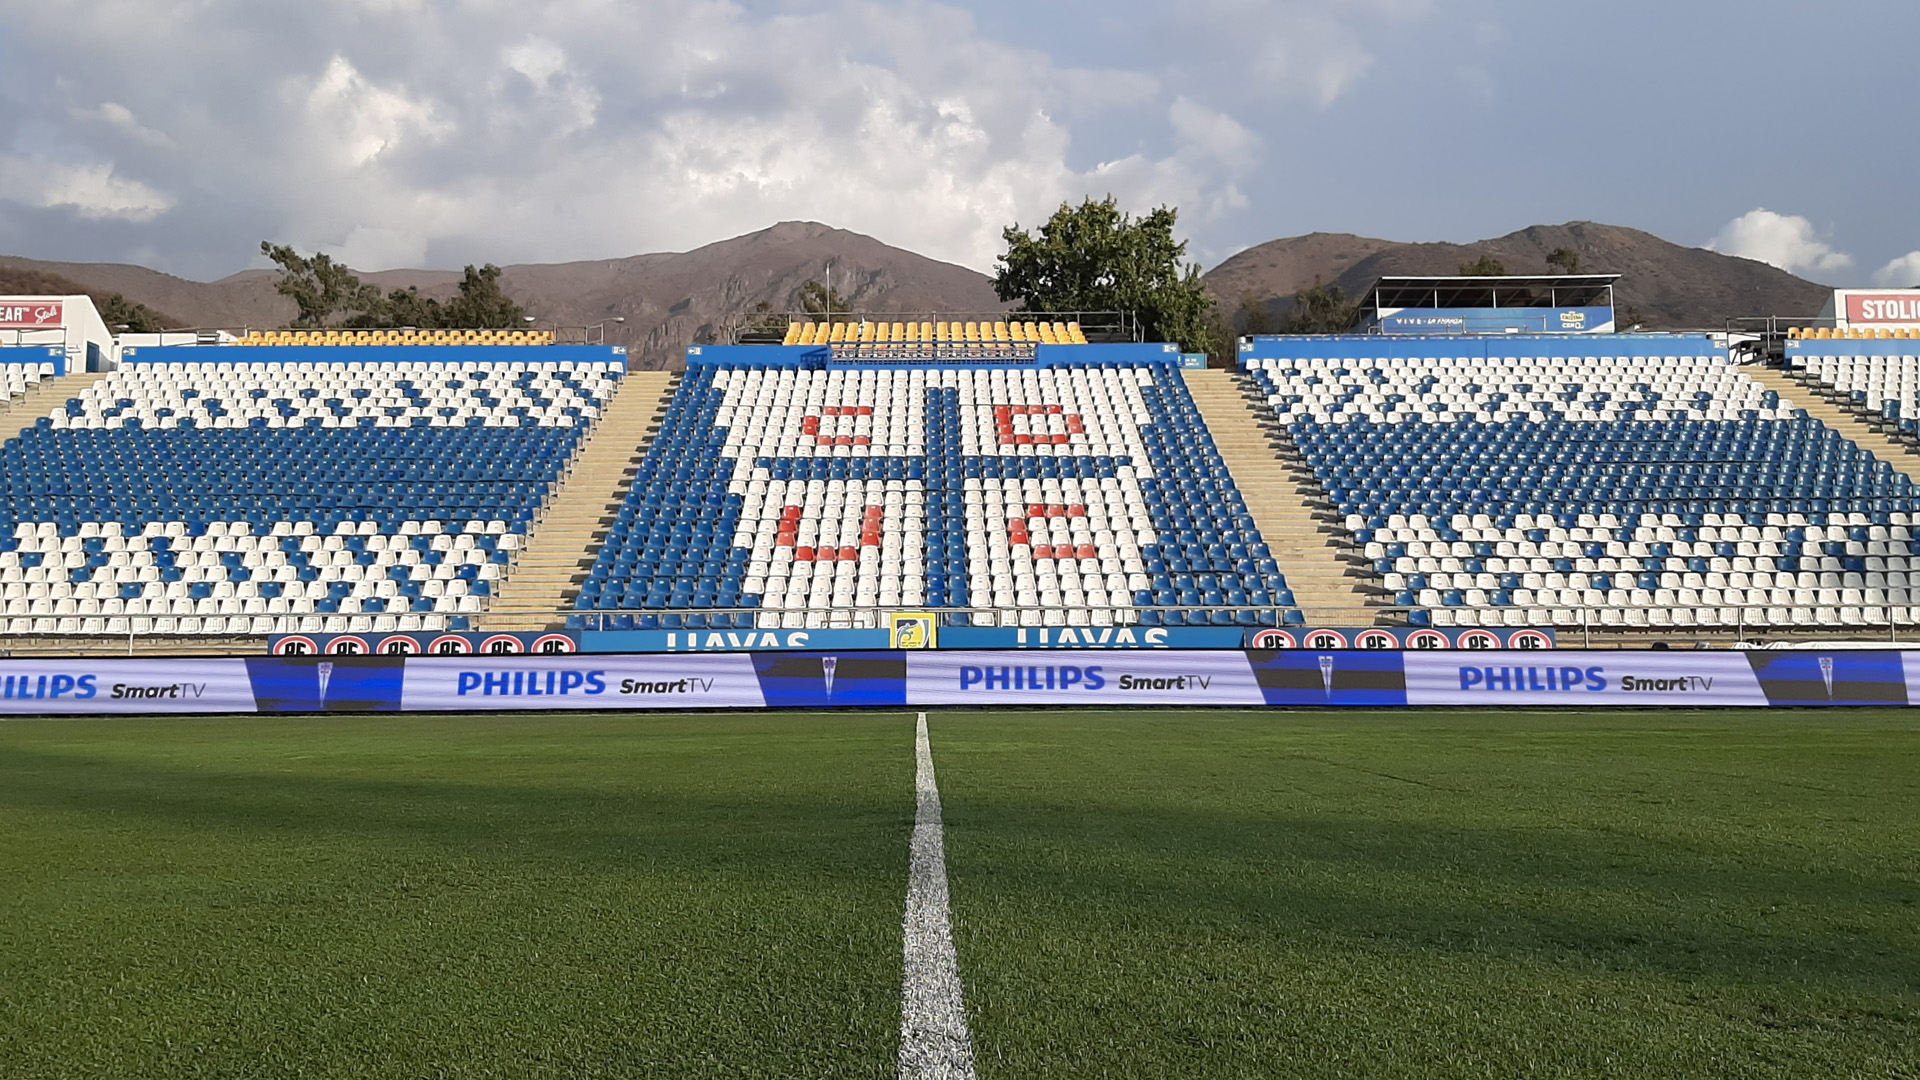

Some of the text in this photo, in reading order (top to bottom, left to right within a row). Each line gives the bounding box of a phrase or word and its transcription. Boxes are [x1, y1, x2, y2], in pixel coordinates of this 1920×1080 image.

[0, 674, 97, 699] ILIPS
[457, 670, 606, 696] PHILIPS
[959, 665, 1106, 690] PHILIPS
[1459, 666, 1607, 691] PHILIPS
